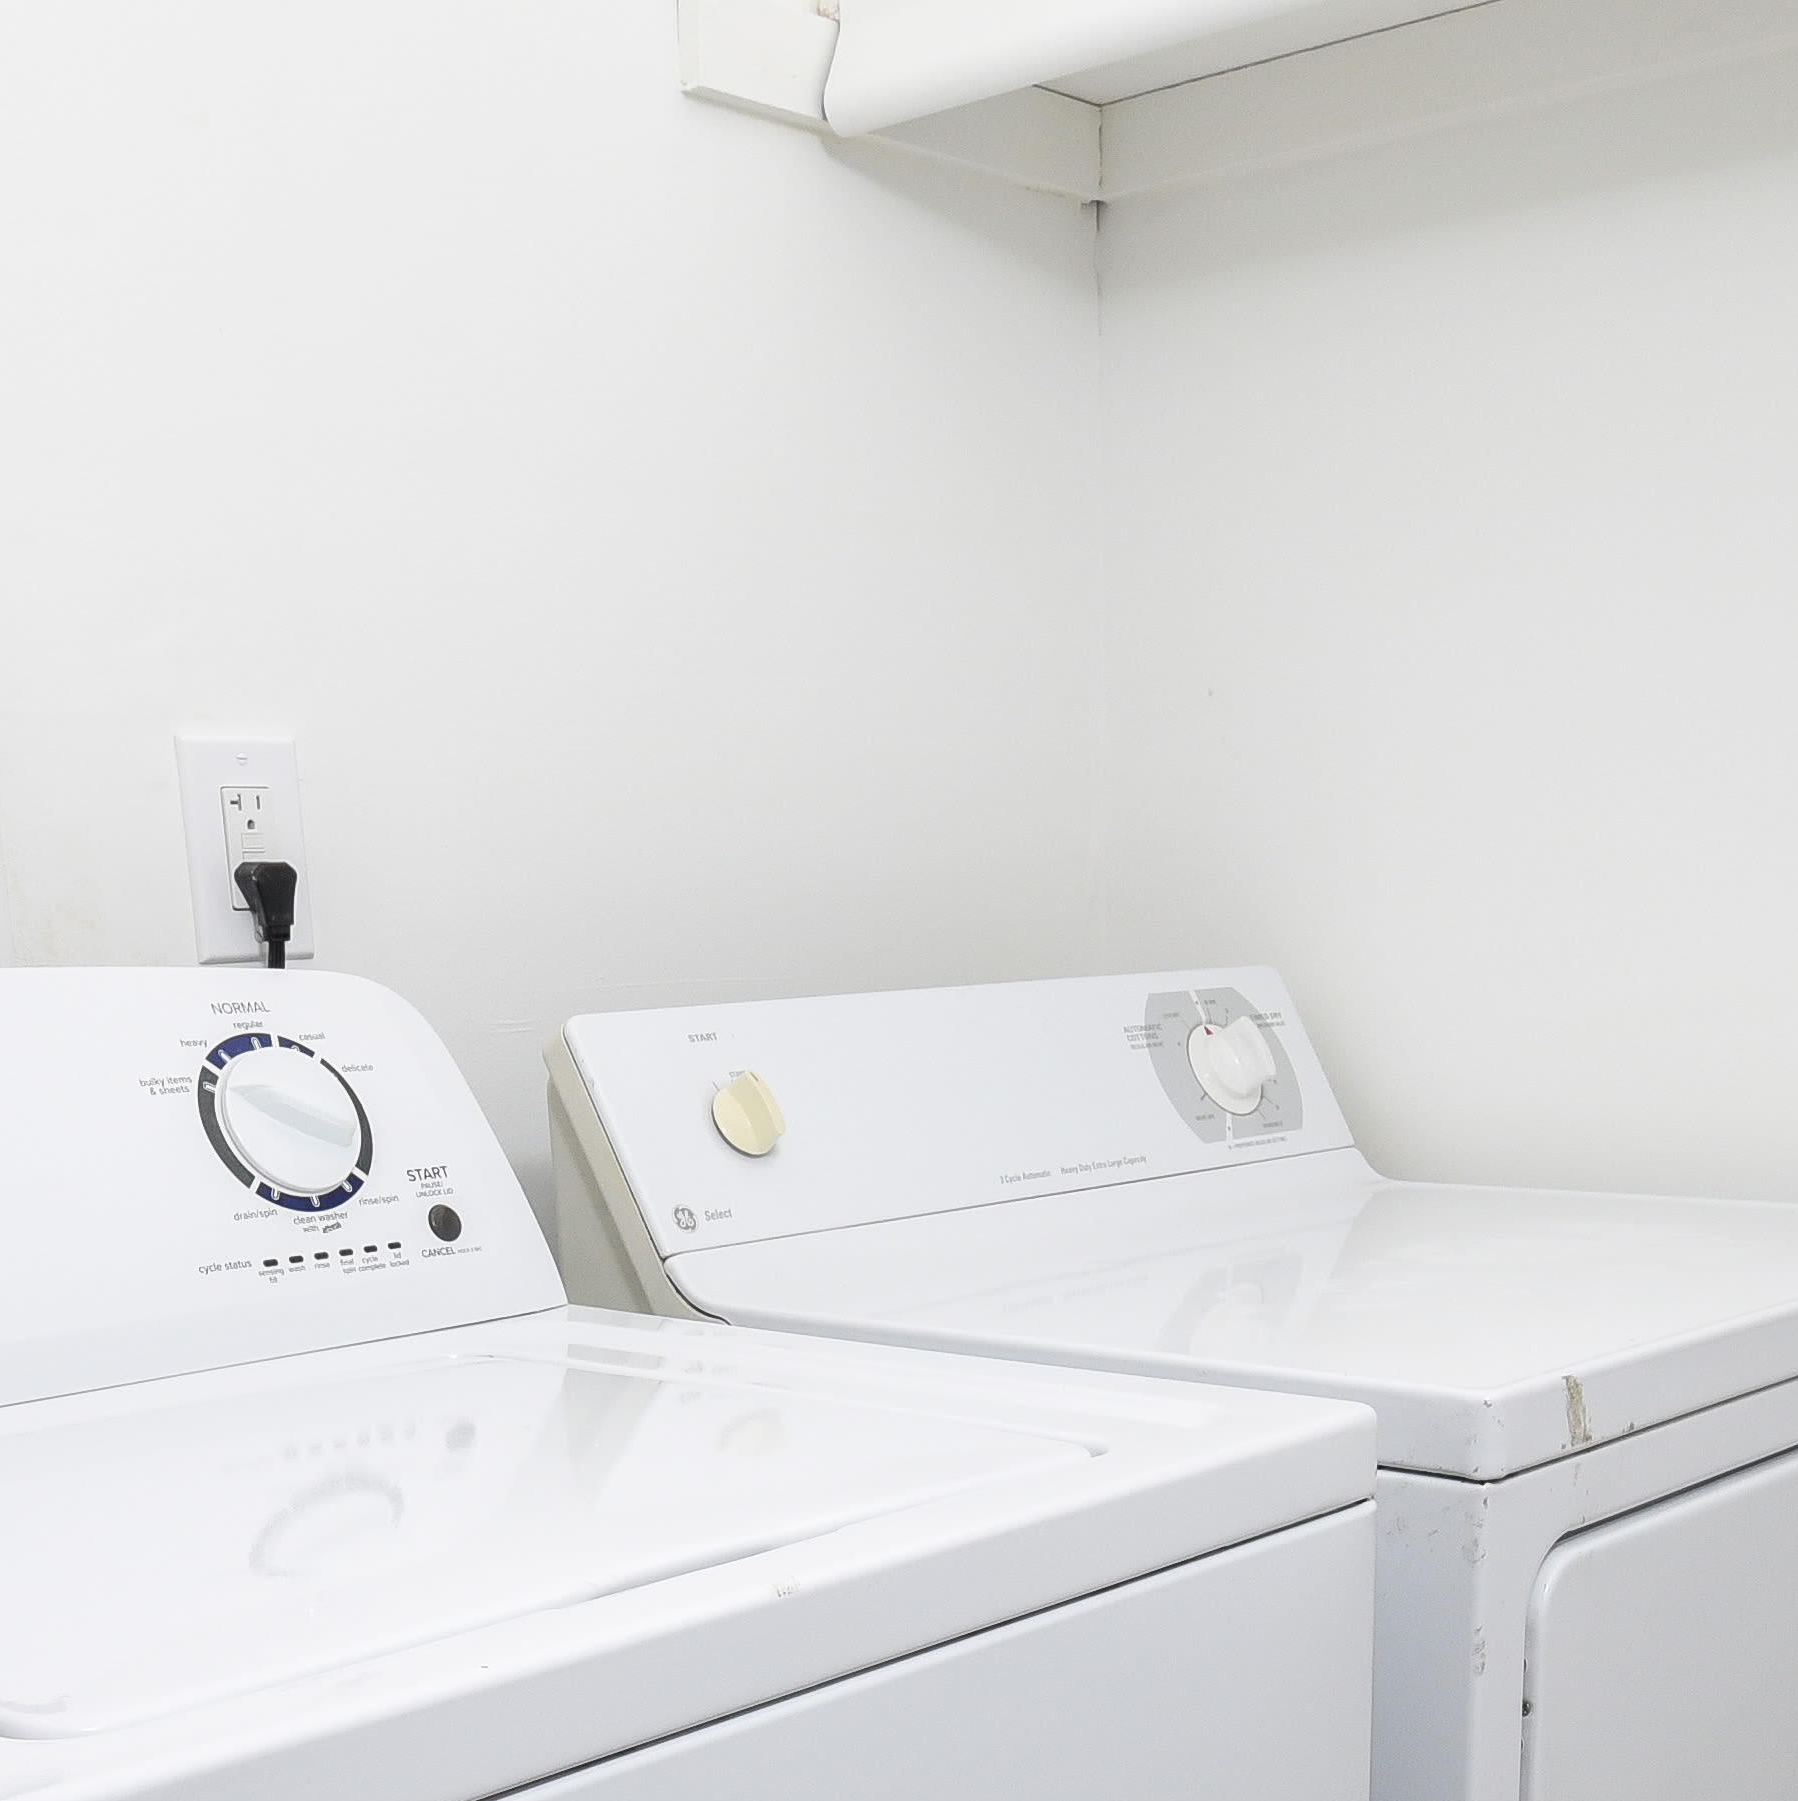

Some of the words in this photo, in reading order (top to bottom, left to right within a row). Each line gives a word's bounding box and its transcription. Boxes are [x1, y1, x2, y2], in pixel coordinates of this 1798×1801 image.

[211, 1001, 271, 1015] NORMAL
[233, 1020, 263, 1030] regular
[687, 1032, 717, 1042] START
[407, 1166, 448, 1182] START
[358, 1194, 399, 1206] rinse/spin
[234, 1207, 278, 1221] drain/spin
[293, 1215, 317, 1225] clean
[319, 1212, 348, 1222] washer
[704, 1209, 733, 1222] Select
[421, 1246, 456, 1258] CANCEL
[198, 1263, 222, 1275] cycle
[225, 1260, 253, 1270] status
